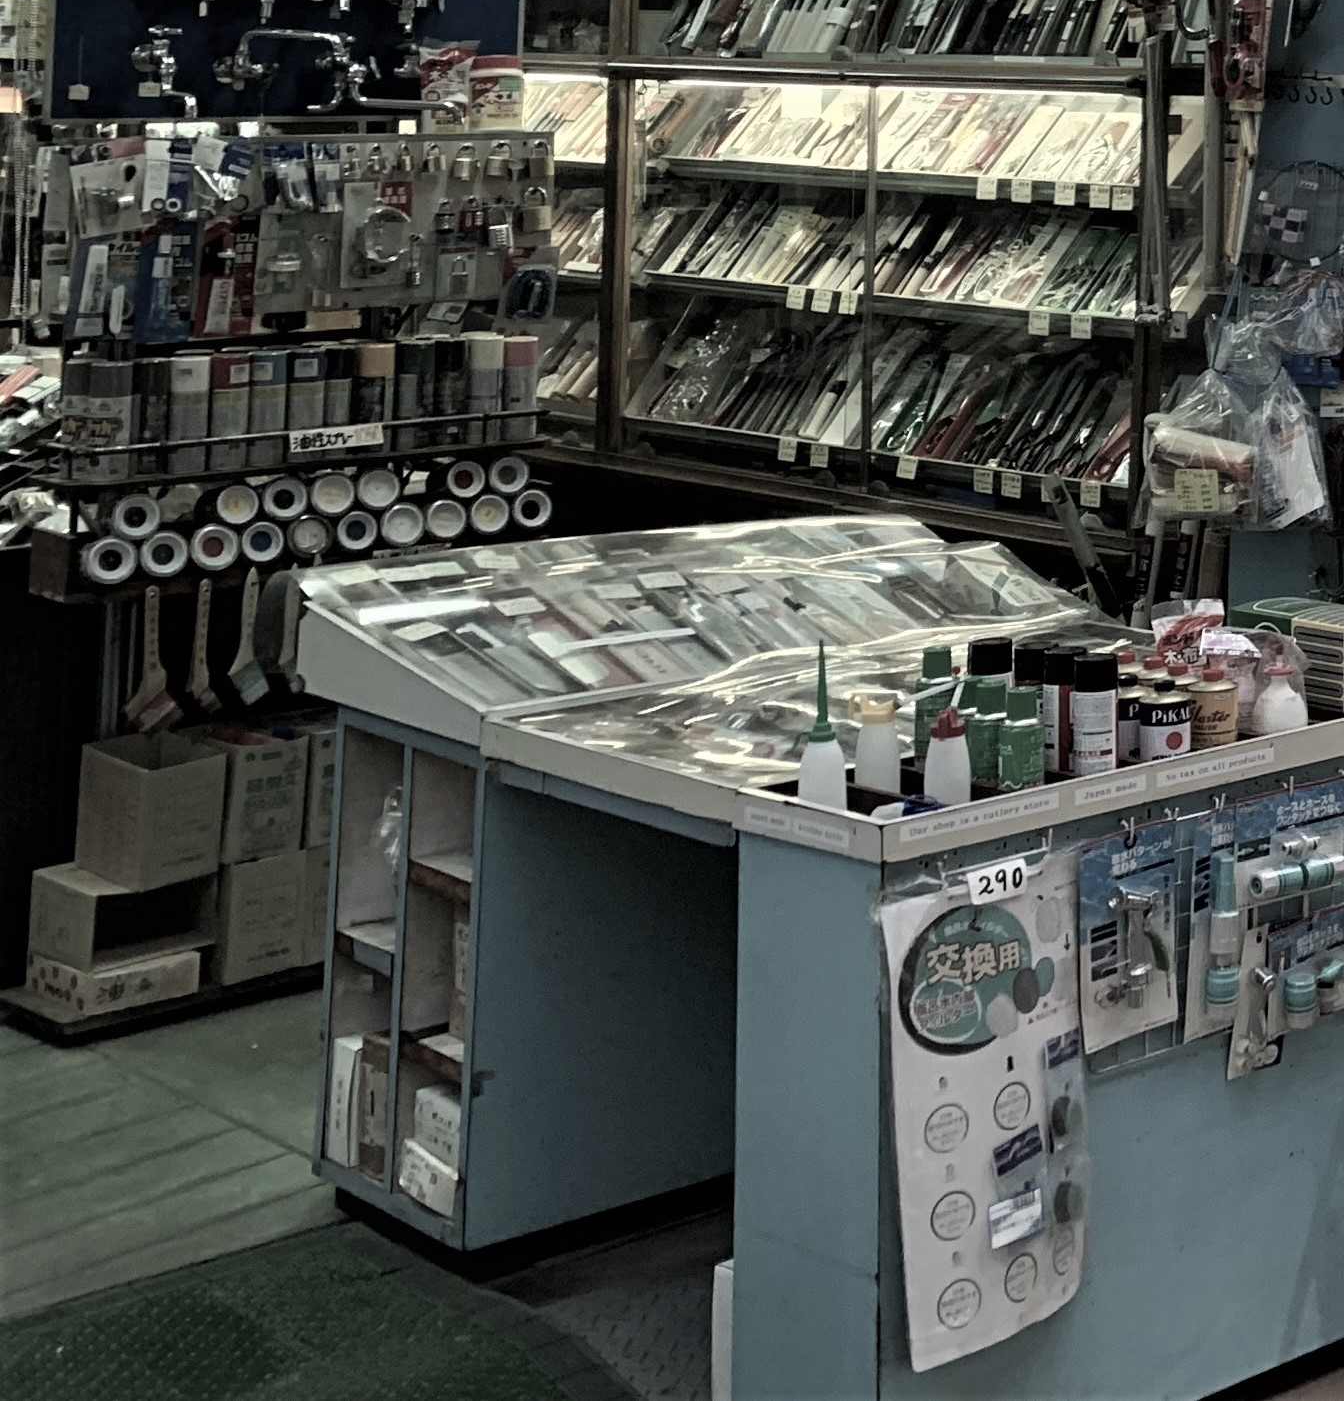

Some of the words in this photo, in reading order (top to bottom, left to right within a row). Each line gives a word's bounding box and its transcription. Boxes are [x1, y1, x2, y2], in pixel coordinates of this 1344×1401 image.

[1083, 787, 1112, 801] Japan
[978, 866, 1023, 897] 290
[926, 940, 1021, 986] 交換用
